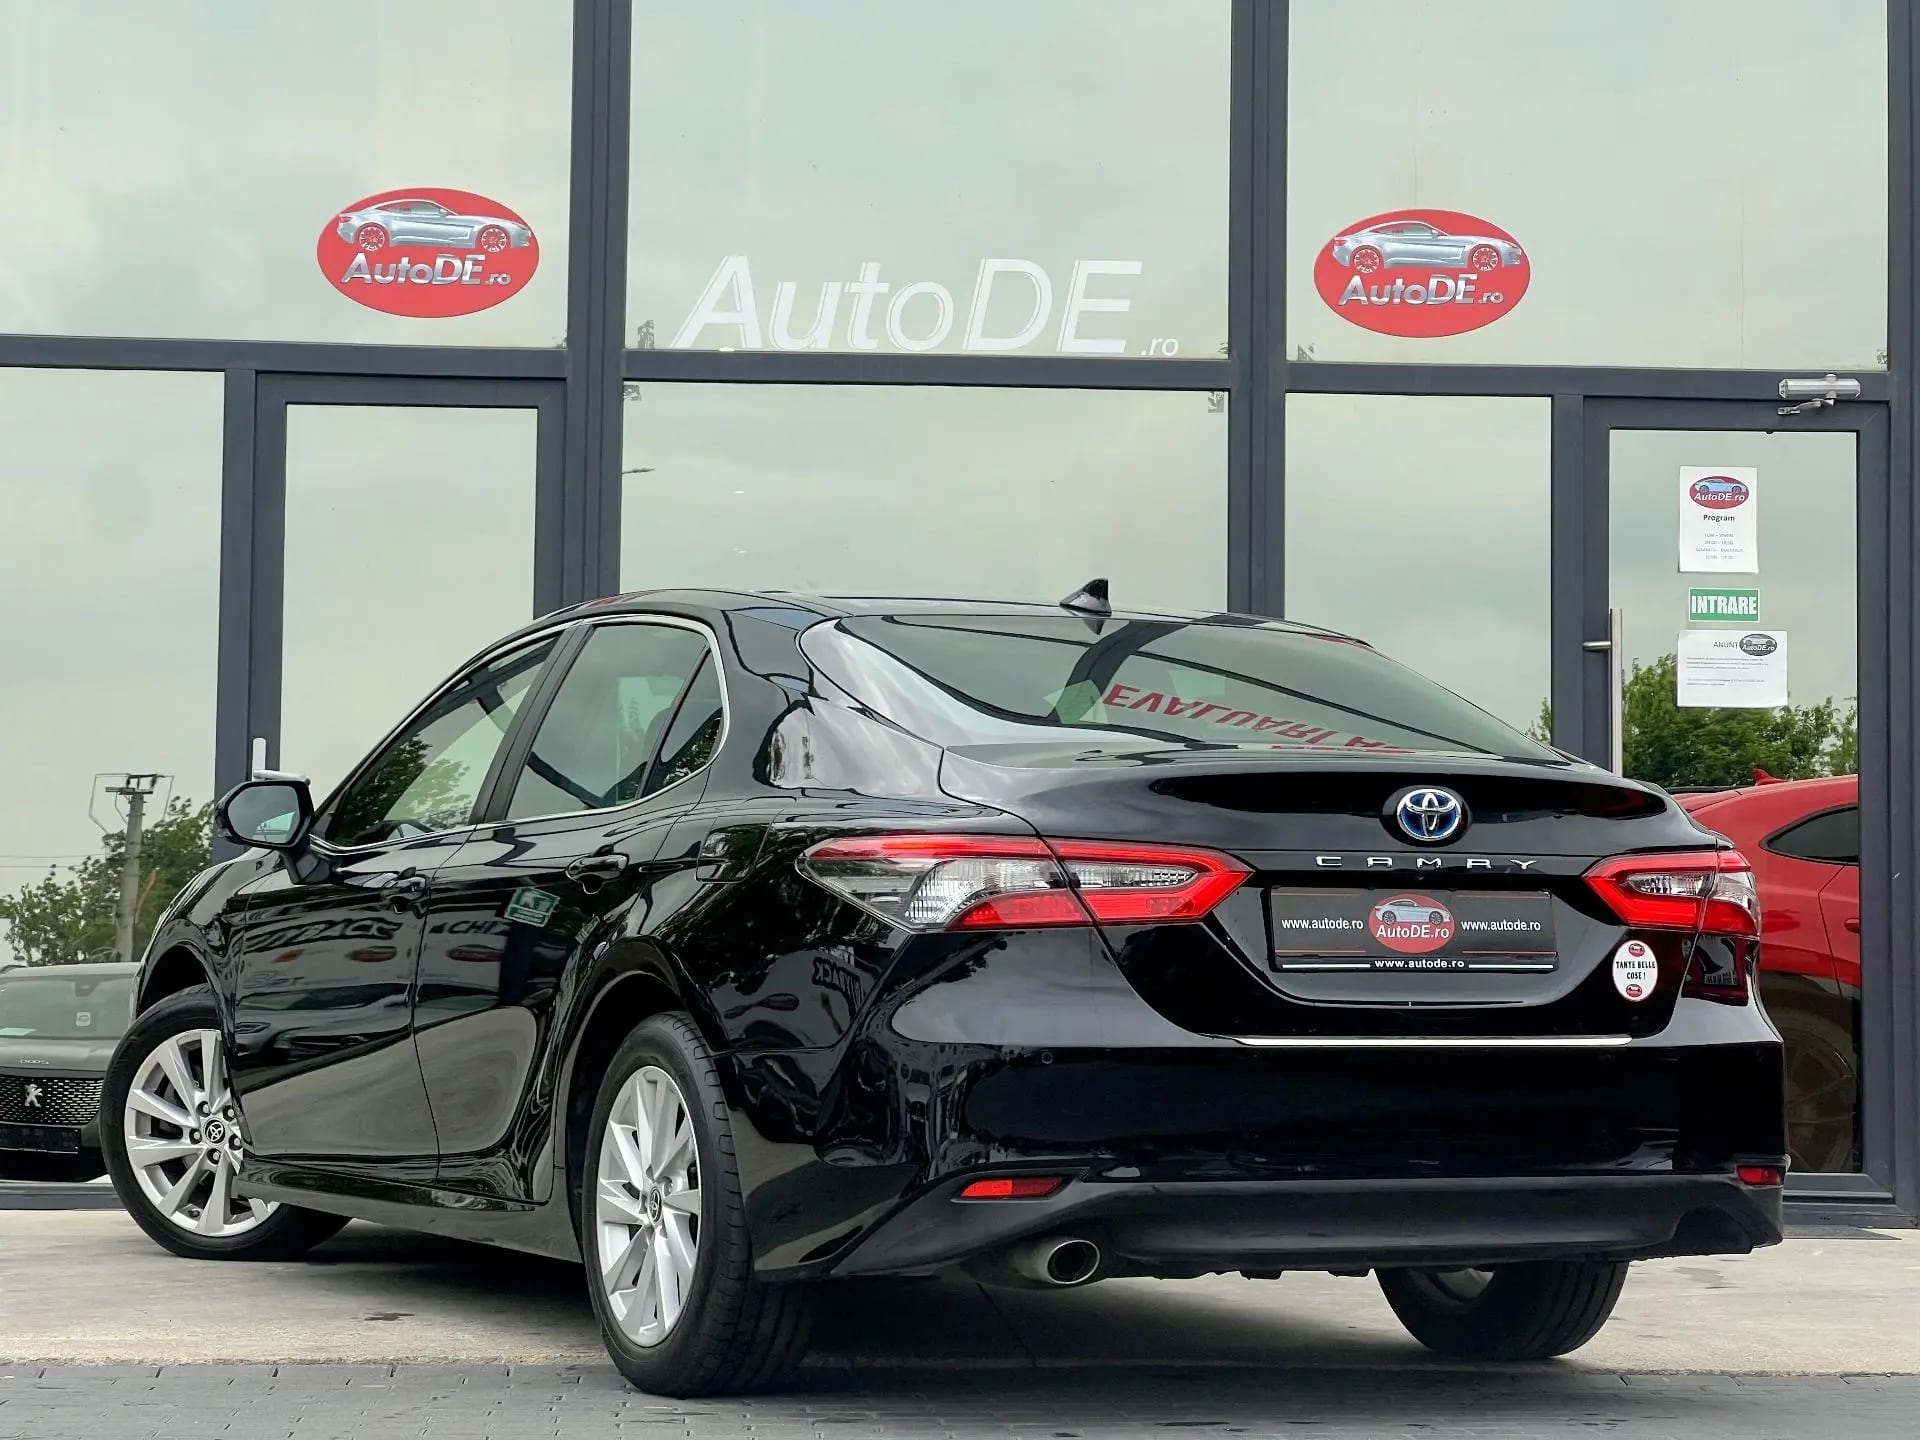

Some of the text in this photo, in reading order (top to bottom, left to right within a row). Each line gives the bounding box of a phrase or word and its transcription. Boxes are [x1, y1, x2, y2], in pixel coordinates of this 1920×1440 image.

[1703, 514, 1735, 522] Program
[1691, 595, 1757, 615] INTRARE
[1315, 855, 1537, 870] CAMRY
[1281, 917, 1364, 930] www.autode.ro
[1461, 918, 1541, 931] www.autode.ro
[1376, 924, 1450, 938] AutoDE.ro
[1374, 958, 1465, 969] www.autode.ro
[1616, 961, 1655, 969] TANTE BELLE
[1626, 971, 1642, 980] COSE
